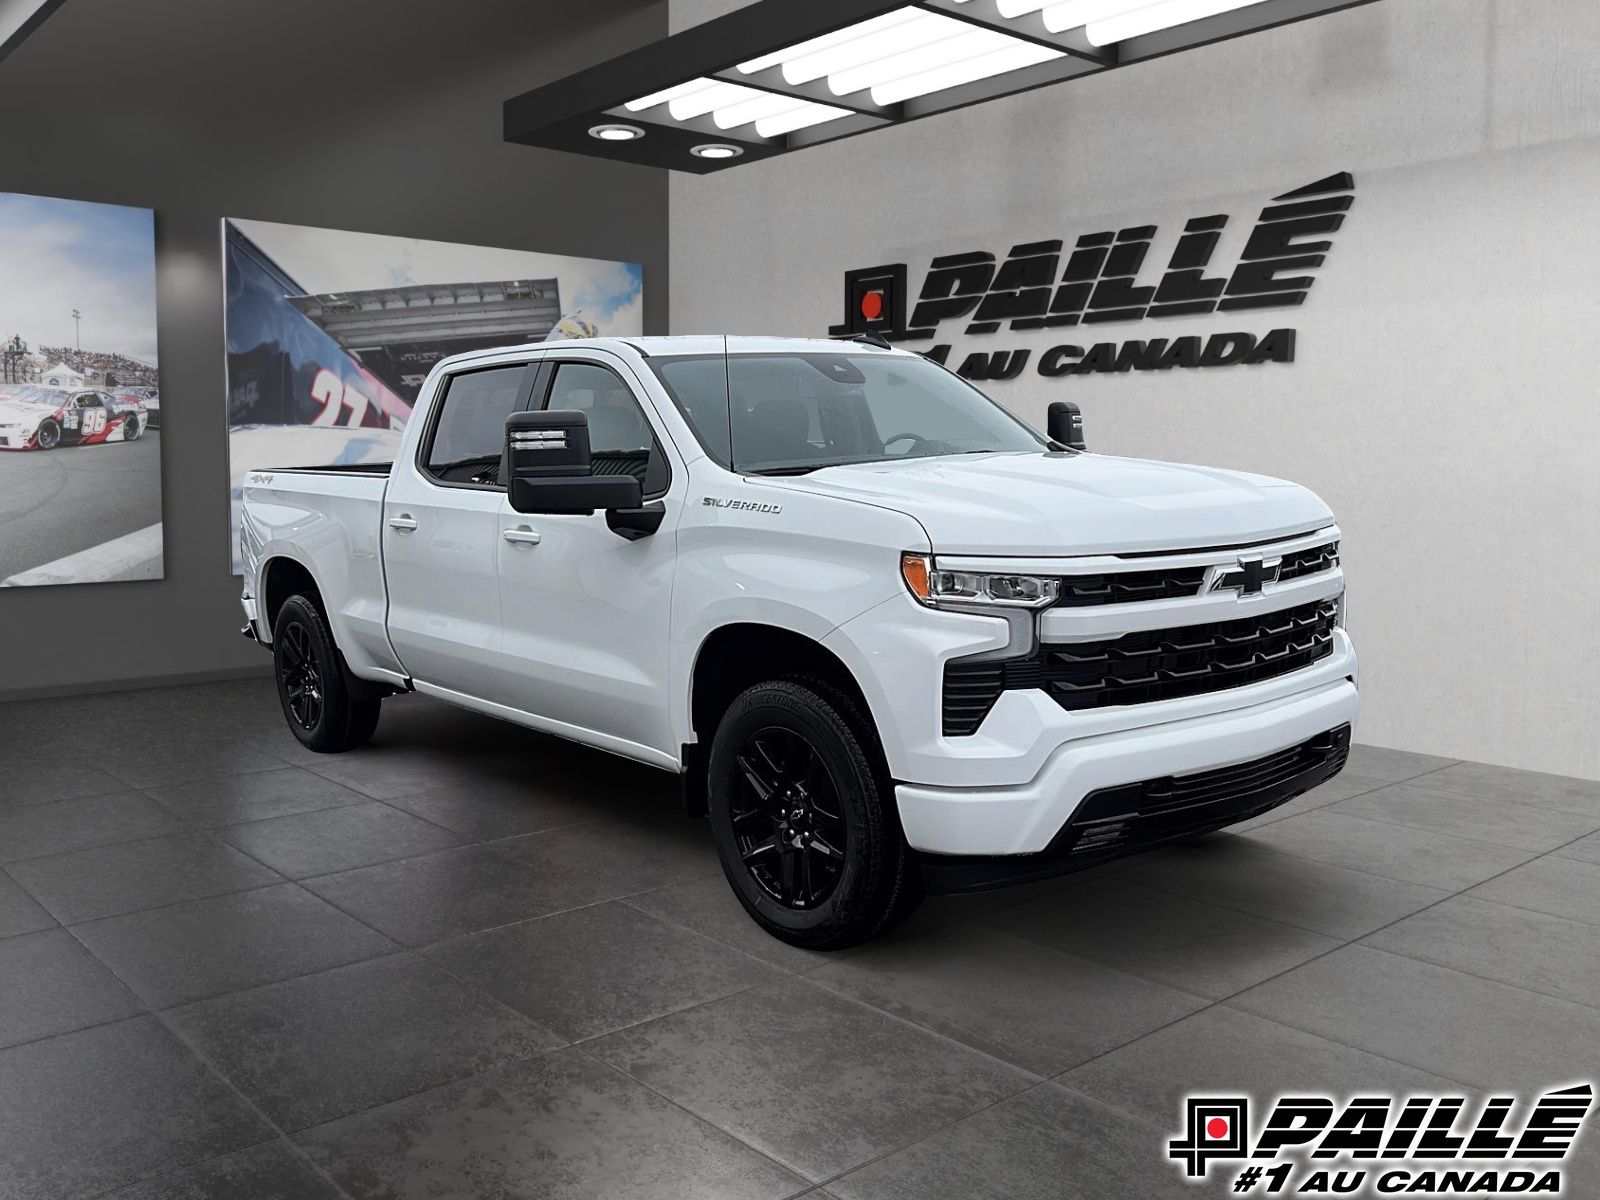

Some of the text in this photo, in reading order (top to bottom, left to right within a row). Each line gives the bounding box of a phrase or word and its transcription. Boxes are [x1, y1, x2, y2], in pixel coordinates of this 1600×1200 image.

[909, 171, 1355, 334] PAILLÉ
[956, 348, 1031, 380] AU
[1038, 328, 1297, 377] CANADA
[81, 407, 107, 436] 96
[310, 368, 369, 427] 27
[702, 496, 783, 515] SILVERADO
